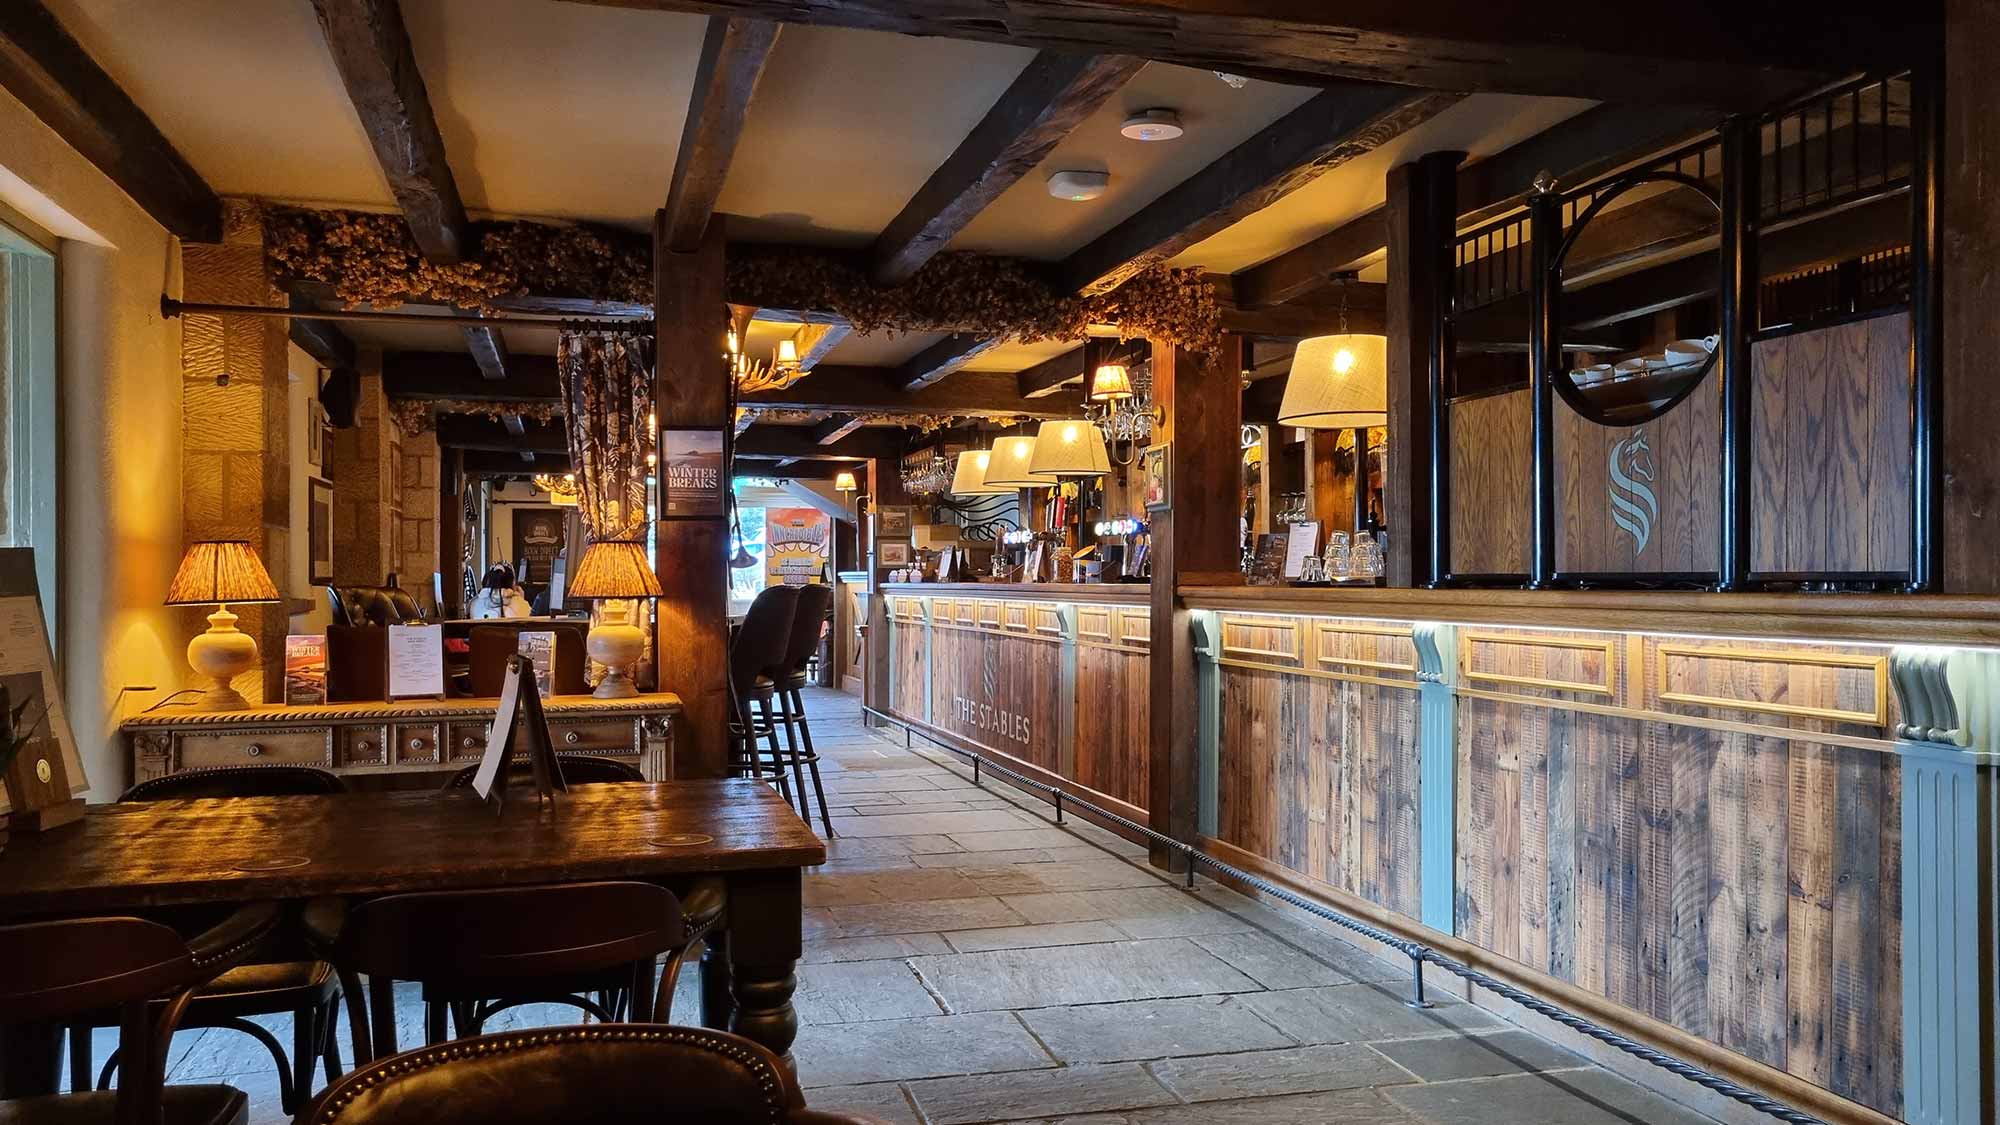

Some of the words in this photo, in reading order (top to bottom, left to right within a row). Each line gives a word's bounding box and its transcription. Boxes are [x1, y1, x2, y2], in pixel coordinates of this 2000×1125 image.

[668, 466, 717, 478] WINTER
[668, 477, 717, 489] BREAKS
[955, 696, 976, 725] THE
[980, 703, 1030, 745] STABLES
